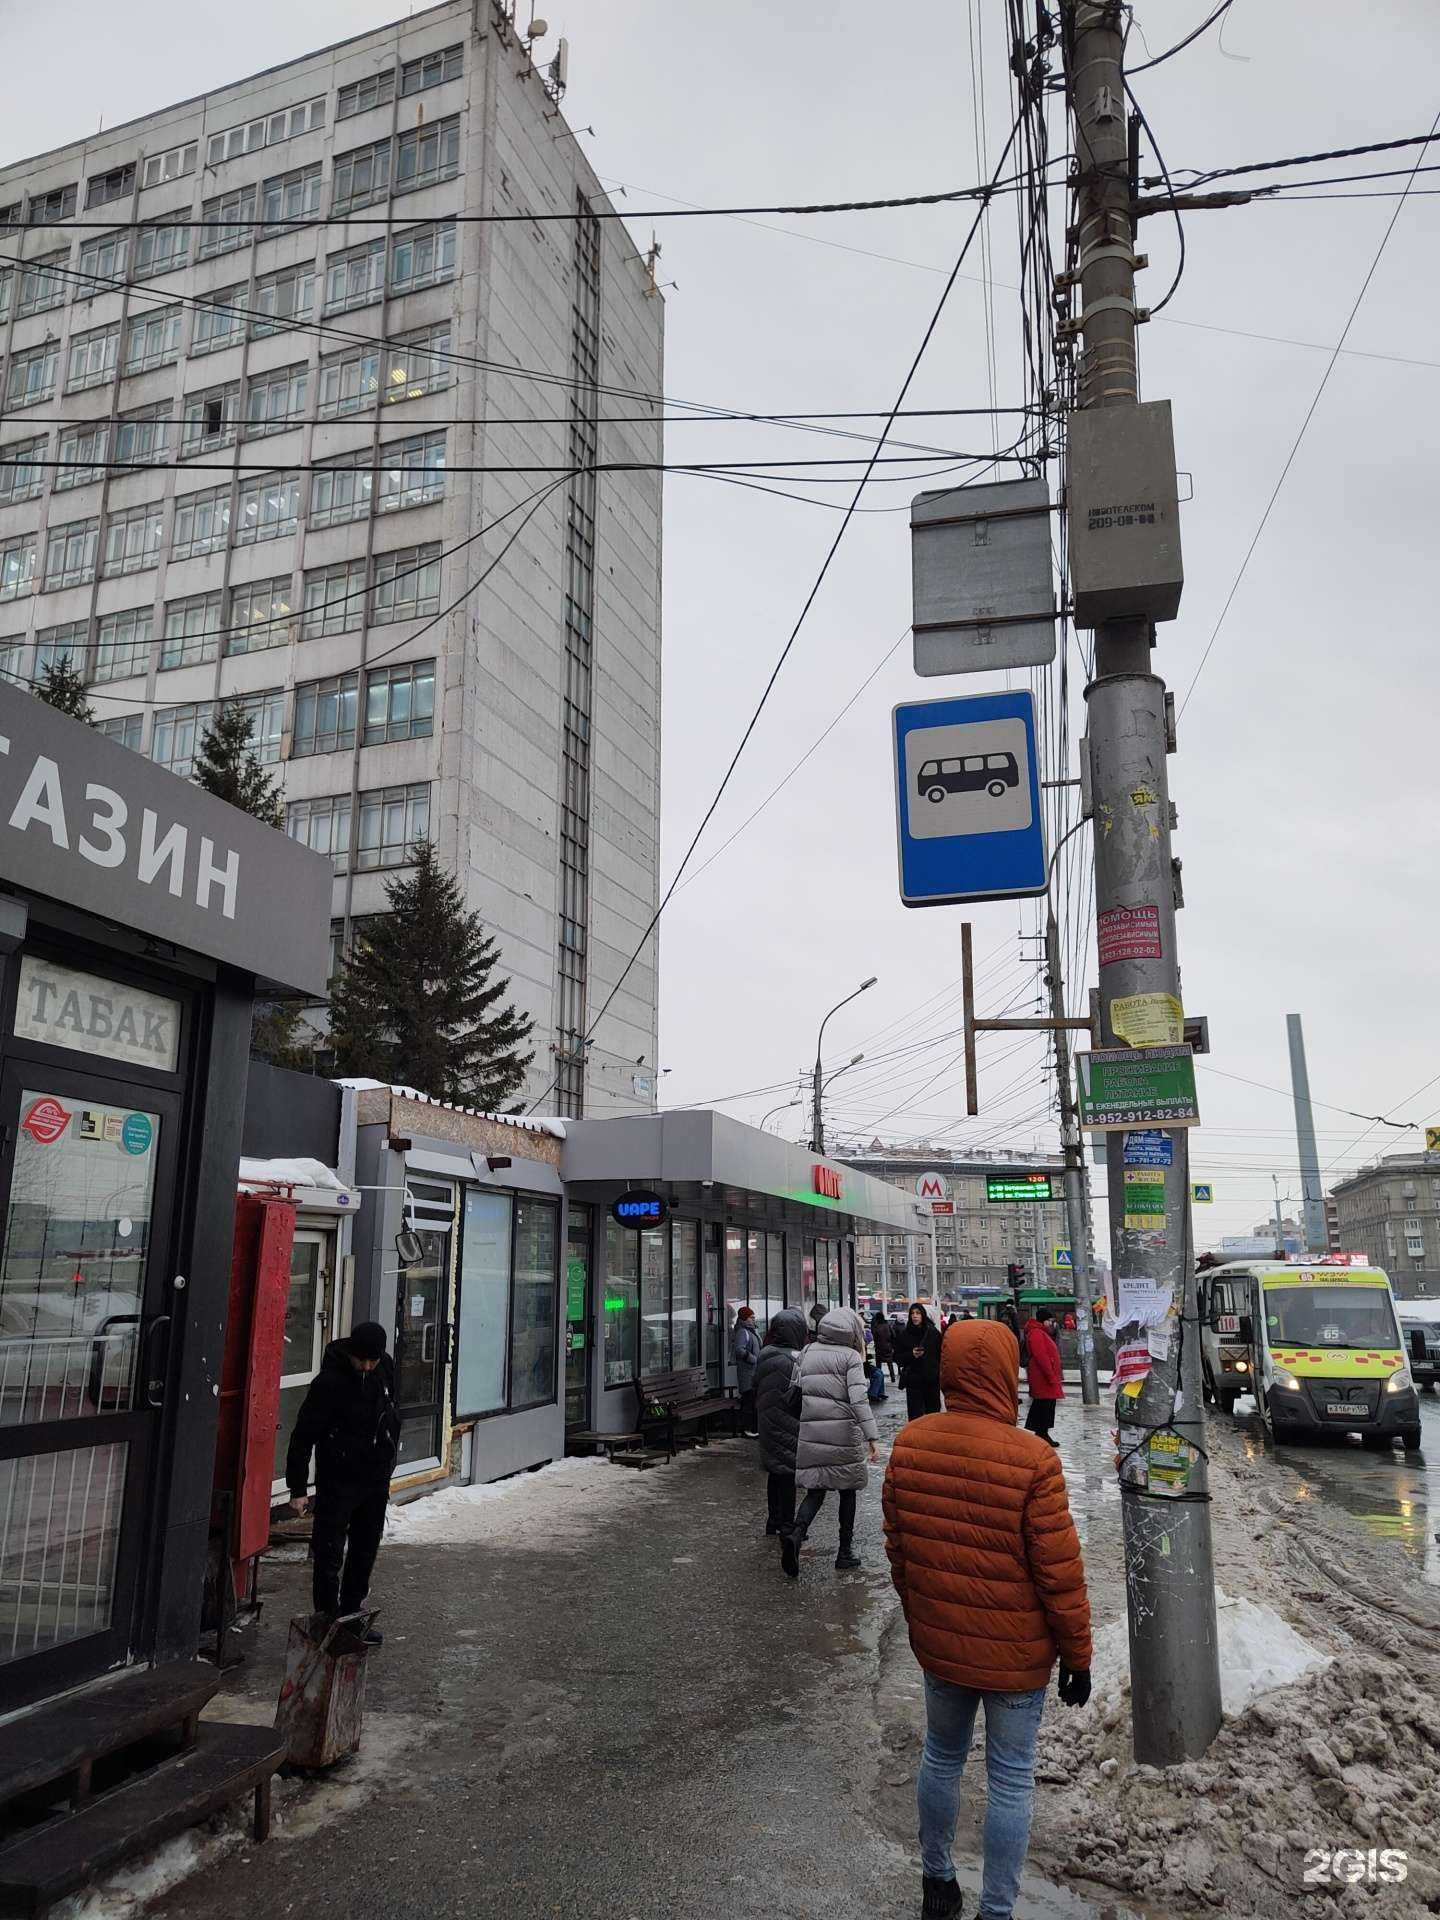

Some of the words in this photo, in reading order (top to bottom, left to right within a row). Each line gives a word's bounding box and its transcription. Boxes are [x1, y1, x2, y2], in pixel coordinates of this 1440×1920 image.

[0, 735, 241, 921] АЗИН
[1113, 998, 1148, 1012] РАБОТА
[28, 974, 169, 1055] ТАБАК
[1102, 1062, 1182, 1076] ПРОЖИВАНИЕ
[1103, 1077, 1149, 1088] РАБОТА
[1104, 1087, 1158, 1099] ПИТАНИЕ
[1096, 1100, 1155, 1111] ЕЖЕНЕДЕЛЬНЫЕ
[1156, 1096, 1194, 1107] ВЫПЛАТЫ
[1086, 1108, 1194, 1125] 8-952-912-82-84
[920, 1178, 943, 1197] М
